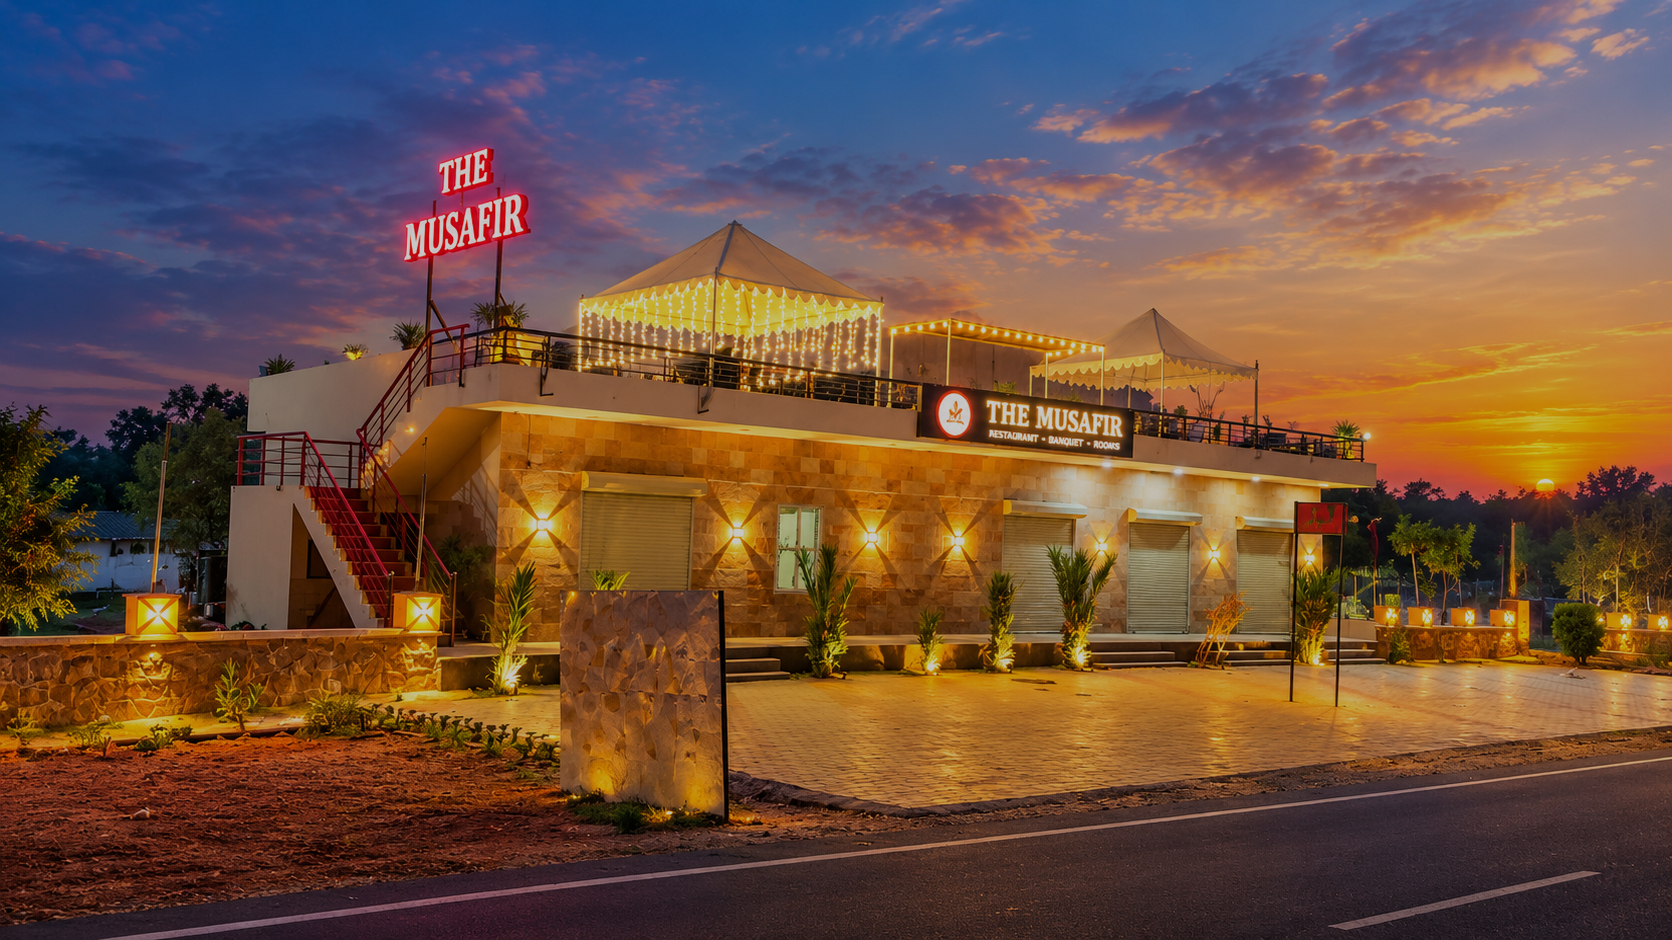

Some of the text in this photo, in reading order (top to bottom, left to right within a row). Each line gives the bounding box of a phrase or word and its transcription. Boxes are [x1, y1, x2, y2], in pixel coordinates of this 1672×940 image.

[438, 148, 490, 194] THE
[404, 194, 526, 261] MUSAFIR
[987, 400, 1123, 438] THE MUSAFIR
[988, 429, 1121, 450] RESTAURANT BANQUET ROOMS
